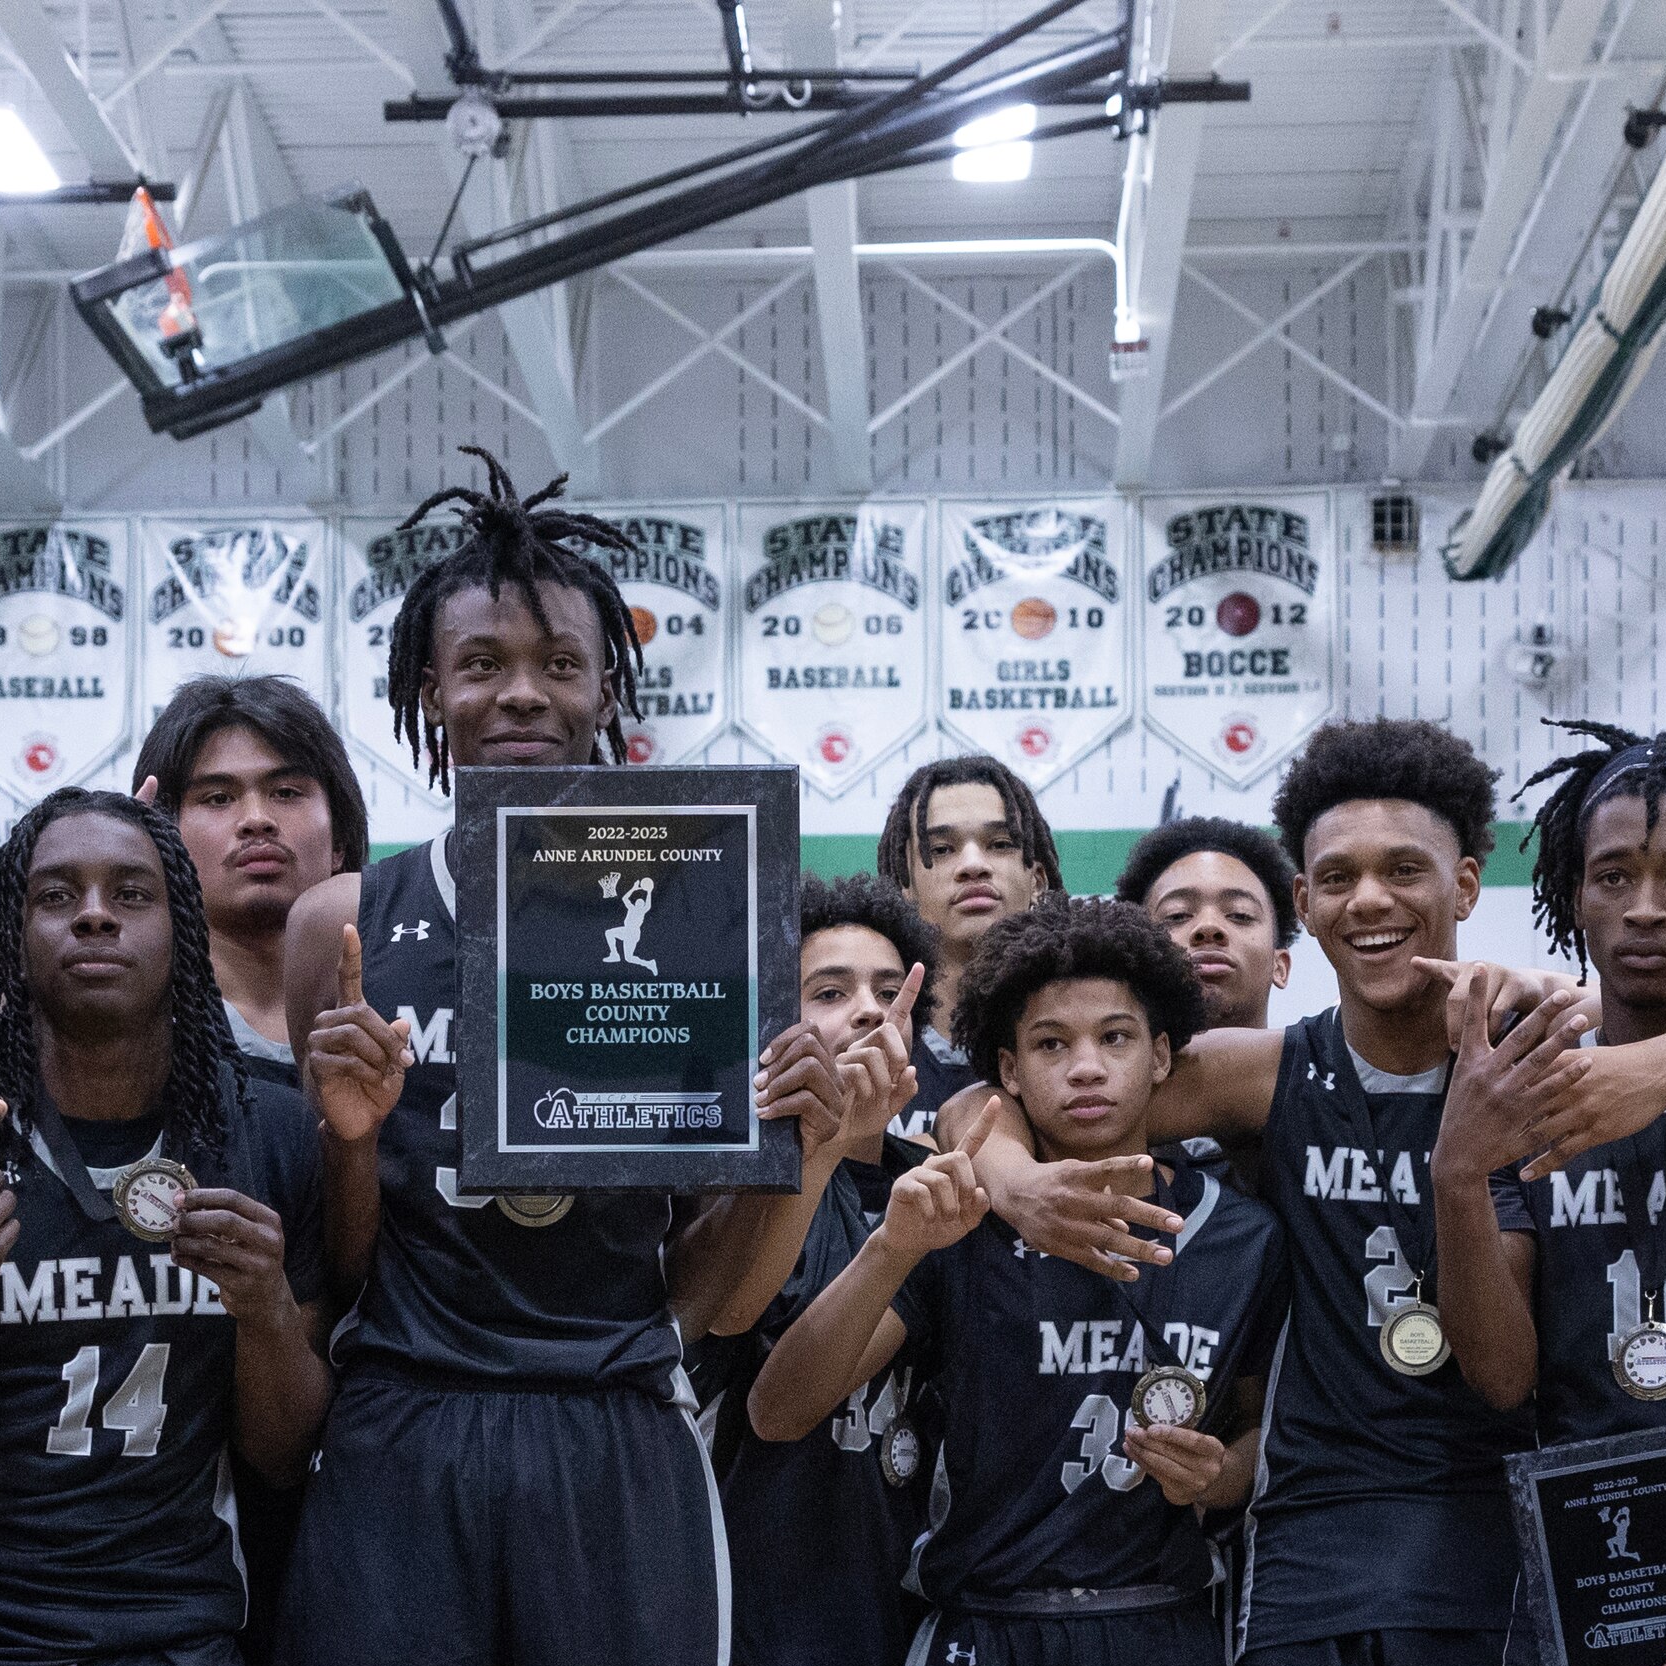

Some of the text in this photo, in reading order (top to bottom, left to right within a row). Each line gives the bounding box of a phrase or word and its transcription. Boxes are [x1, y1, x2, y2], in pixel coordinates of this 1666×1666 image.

[764, 515, 904, 558] STAE
[1166, 504, 1308, 548] STATE
[745, 548, 920, 613] CHAMPONS
[1148, 538, 1319, 603] CHAMPIONS
[666, 614, 706, 636] 04
[762, 615, 801, 636] 20
[1068, 607, 1105, 628] 10
[1165, 604, 1307, 628] 20 12
[70, 625, 109, 648] 98
[168, 626, 205, 649] 20
[997, 659, 1071, 682] GIRLS
[1183, 648, 1290, 677] BOCCE
[767, 666, 901, 689] BASEBALL
[948, 687, 1119, 710] BASKETBALL
[587, 826, 669, 840] 2022-2023
[532, 848, 724, 863] ANNE ARUNDEL COUNTY
[530, 982, 727, 1000] BOYS BASKETBALL
[585, 1005, 670, 1022] COUNTY
[565, 1027, 691, 1044] CHAMPIONS
[546, 1098, 723, 1130] ATHLETICS
[1303, 1144, 1431, 1205] MEA
[1038, 1319, 1220, 1382] MEADE
[46, 1343, 171, 1457] 14
[1592, 1476, 1639, 1492] 2022-2023
[1563, 1495, 1589, 1509] ANNE
[1590, 1489, 1633, 1505] ARUNDEL
[1576, 1572, 1607, 1589] BOYS
[1608, 1581, 1656, 1599] COUNTY
